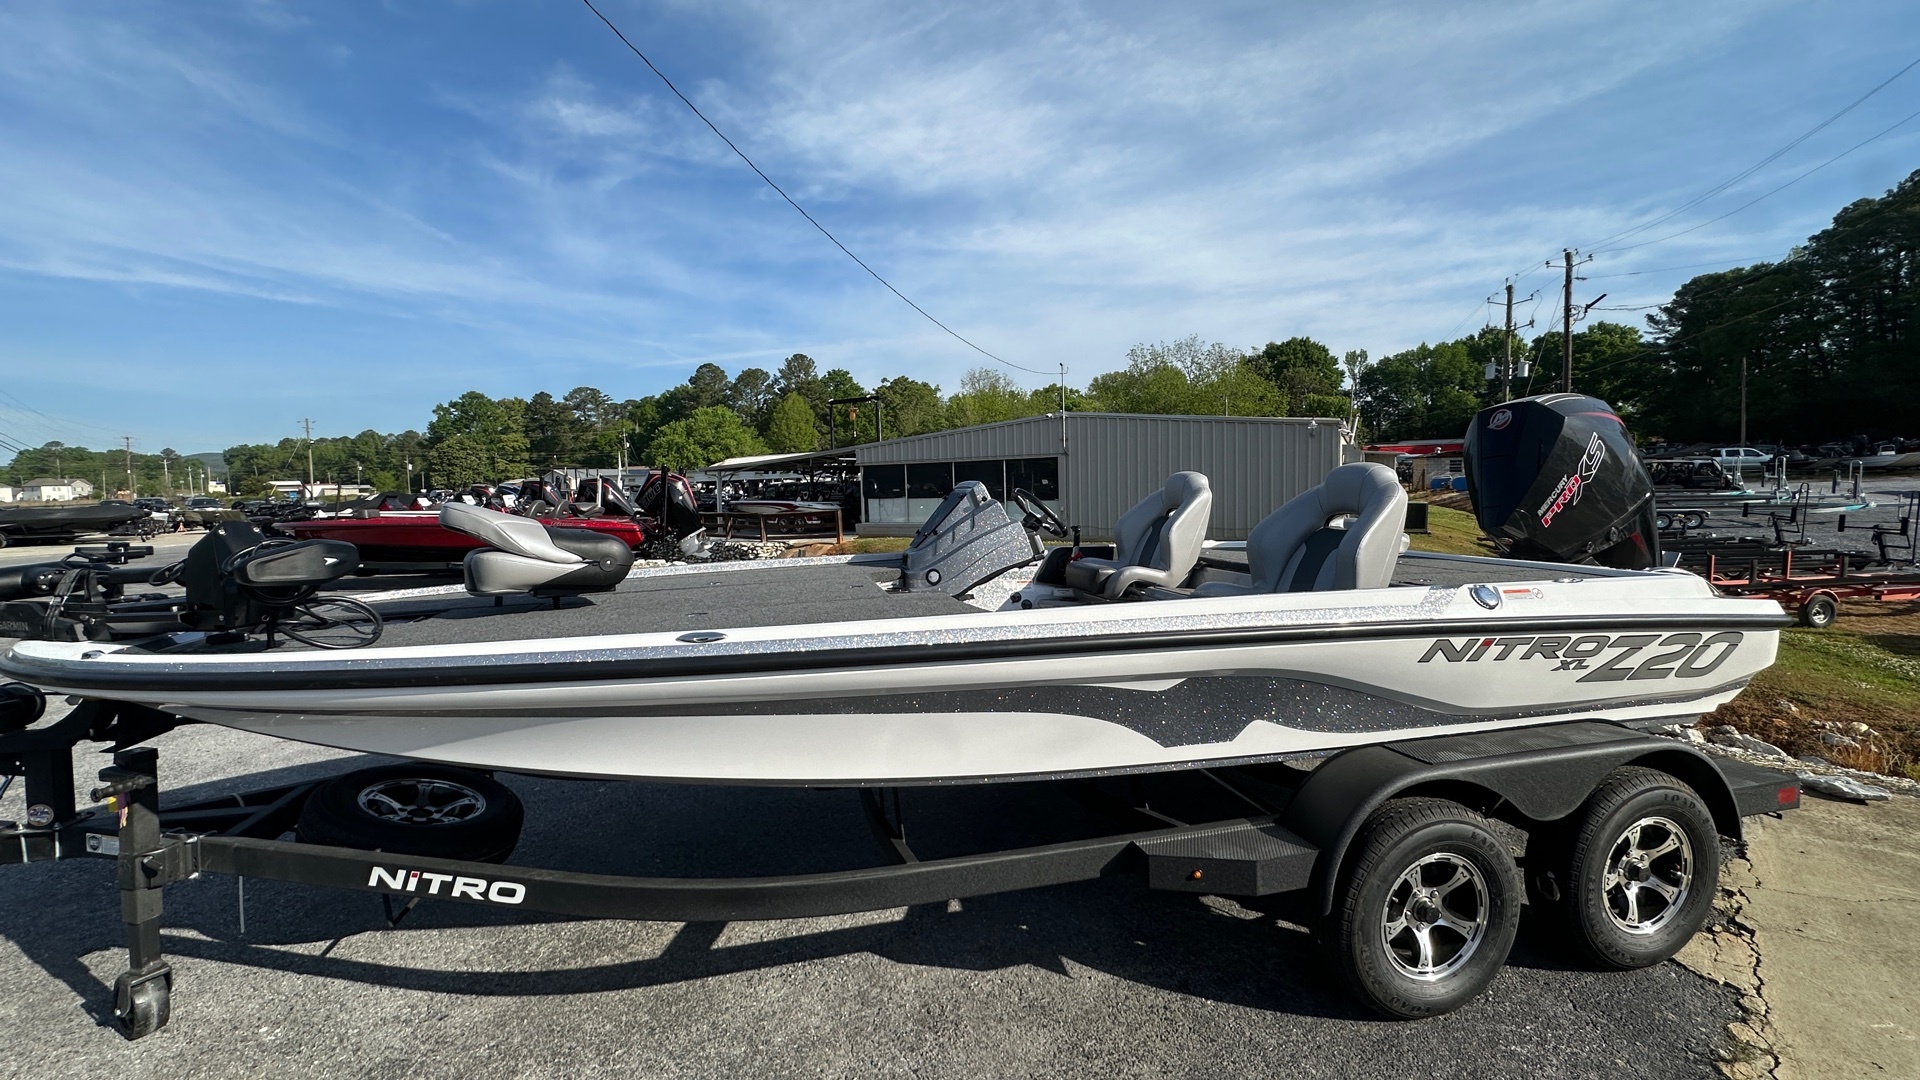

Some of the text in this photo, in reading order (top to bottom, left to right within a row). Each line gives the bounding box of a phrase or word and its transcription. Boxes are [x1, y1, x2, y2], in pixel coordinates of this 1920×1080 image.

[1537, 474, 1568, 517] MERCURY
[1417, 635, 1611, 663] NITRO
[1550, 659, 1590, 672] XL
[1575, 631, 1744, 683] Z20
[368, 866, 526, 904] NITRO
